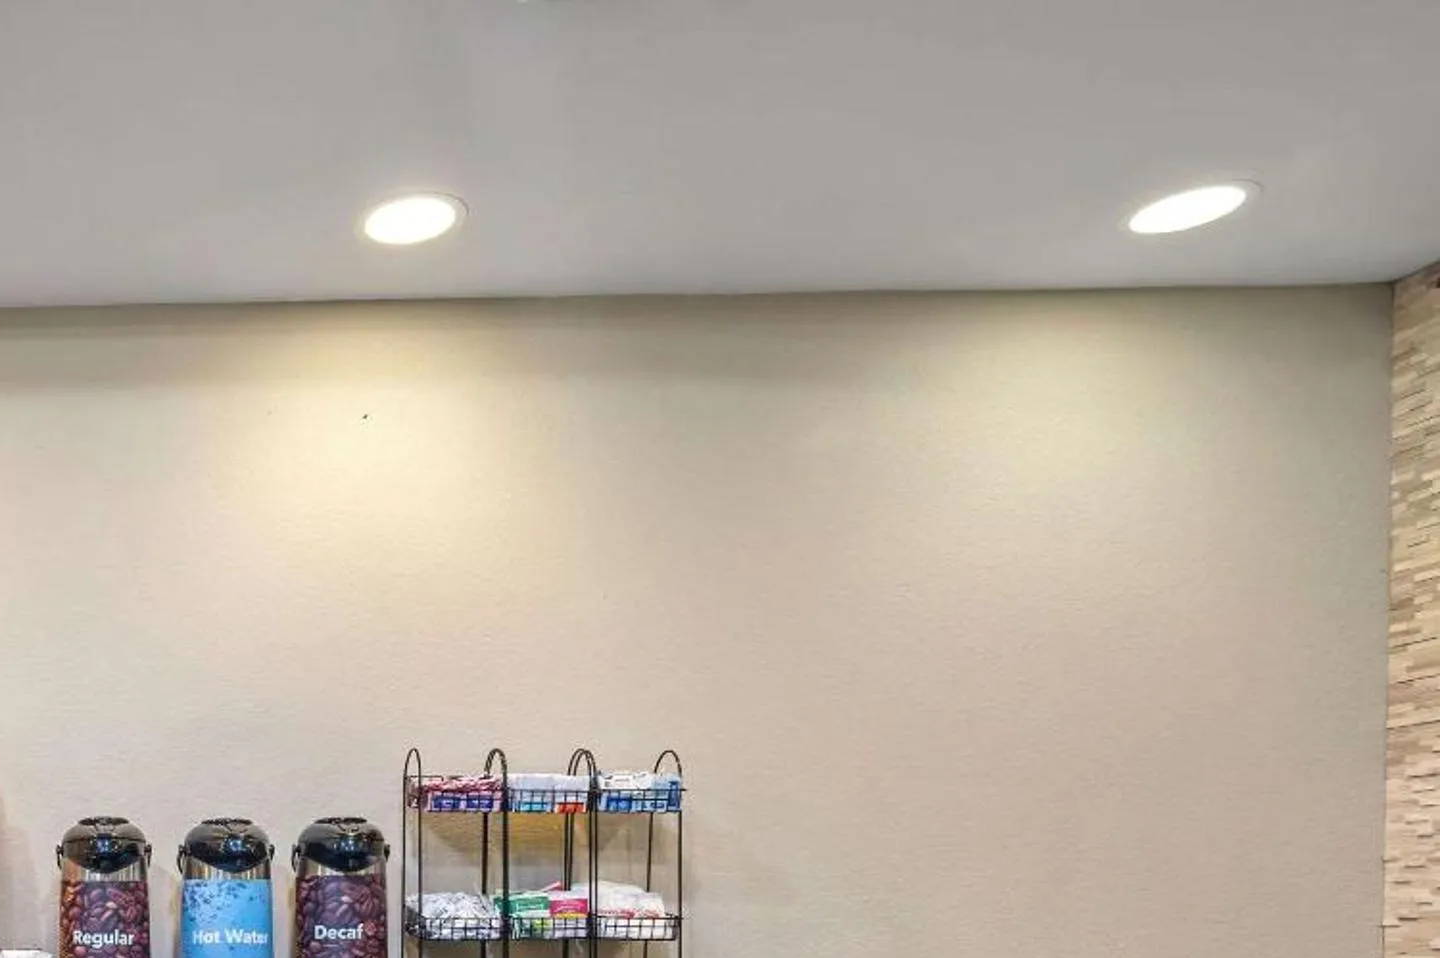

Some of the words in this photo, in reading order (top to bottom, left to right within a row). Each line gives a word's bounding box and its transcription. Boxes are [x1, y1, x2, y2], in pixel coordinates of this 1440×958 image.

[72, 928, 135, 949] Regular
[192, 929, 220, 945] Hot
[224, 928, 268, 945] Water
[314, 922, 364, 940] Decaf
